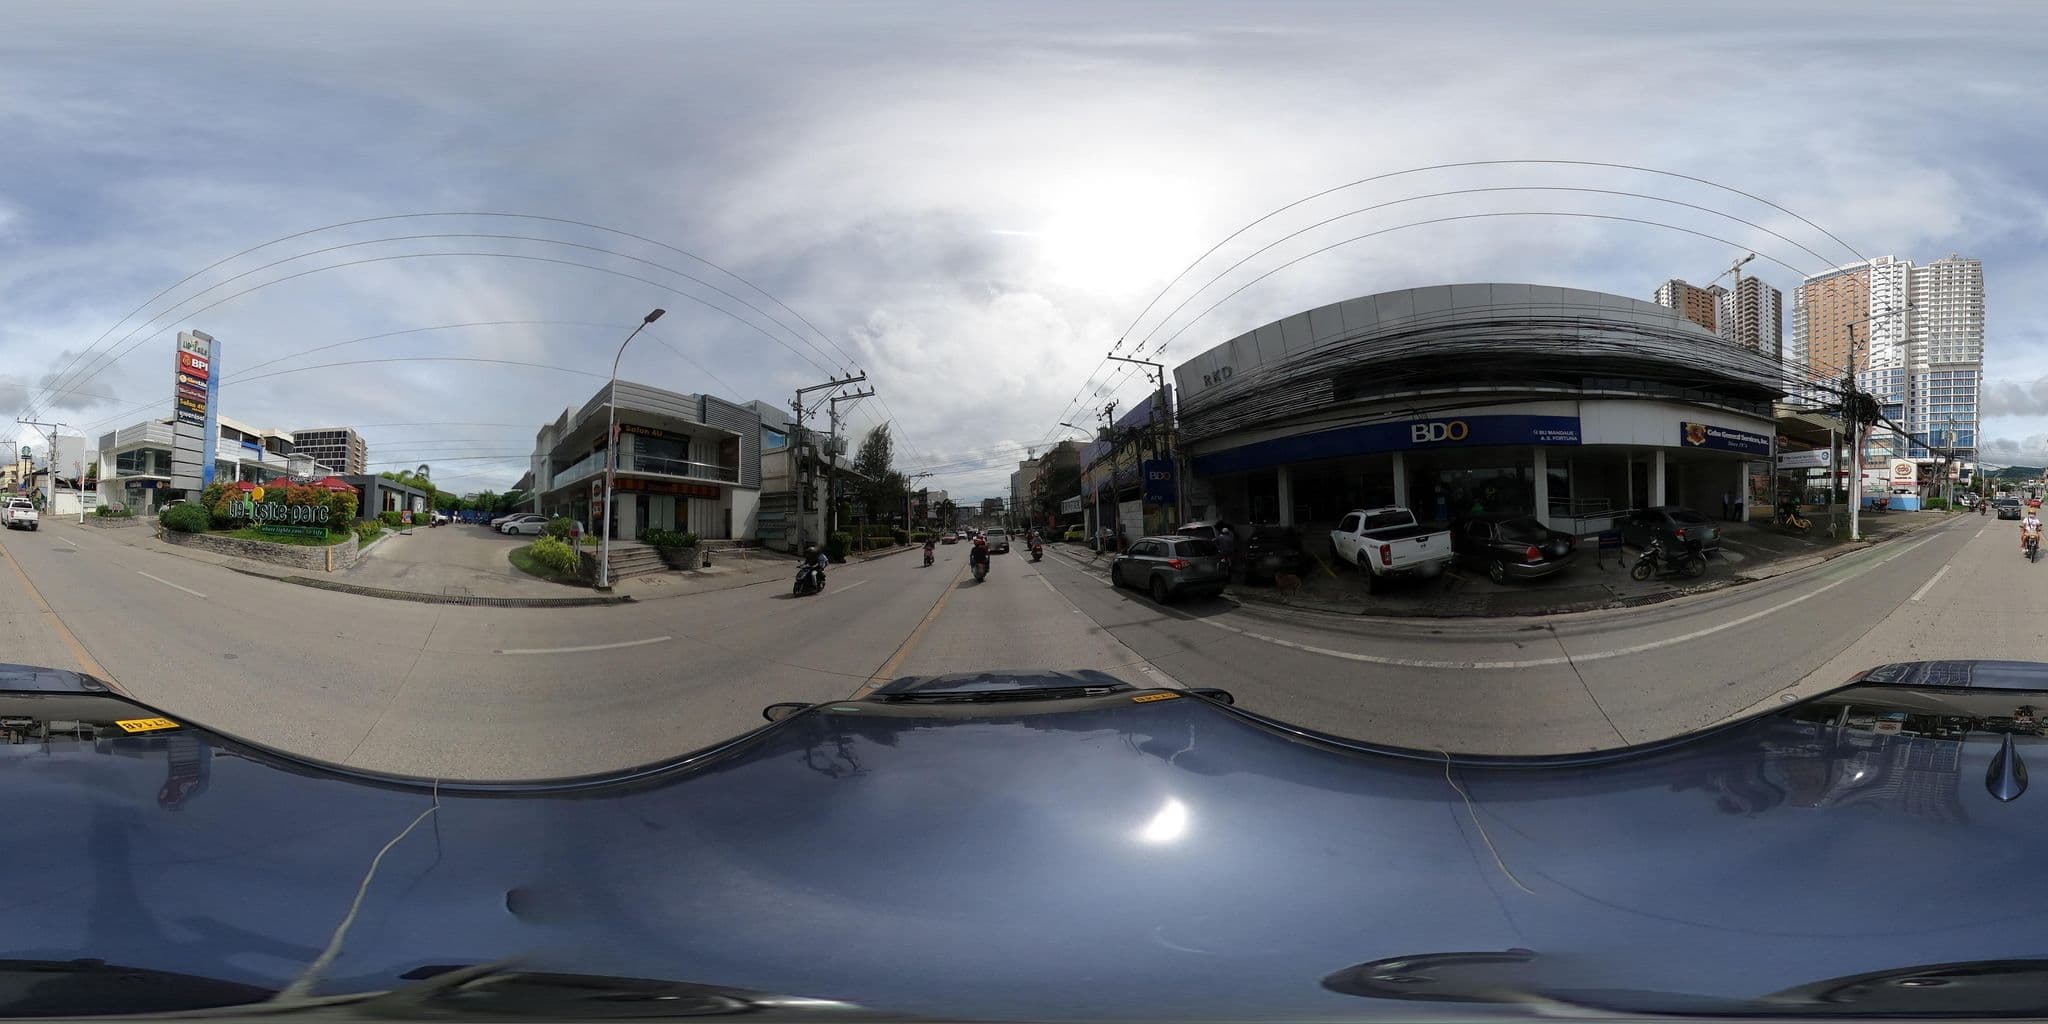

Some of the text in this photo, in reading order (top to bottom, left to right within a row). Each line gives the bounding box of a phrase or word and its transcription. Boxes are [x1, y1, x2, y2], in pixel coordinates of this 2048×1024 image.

[191, 358, 208, 372] BPI
[1203, 366, 1232, 387] RKD
[625, 425, 663, 437] Salon 4U
[1411, 420, 1469, 443] BDO
[1707, 429, 1721, 437] Cebu
[1721, 431, 1741, 440] General
[1149, 471, 1171, 480] BDO
[229, 492, 329, 524] lightsite parc
